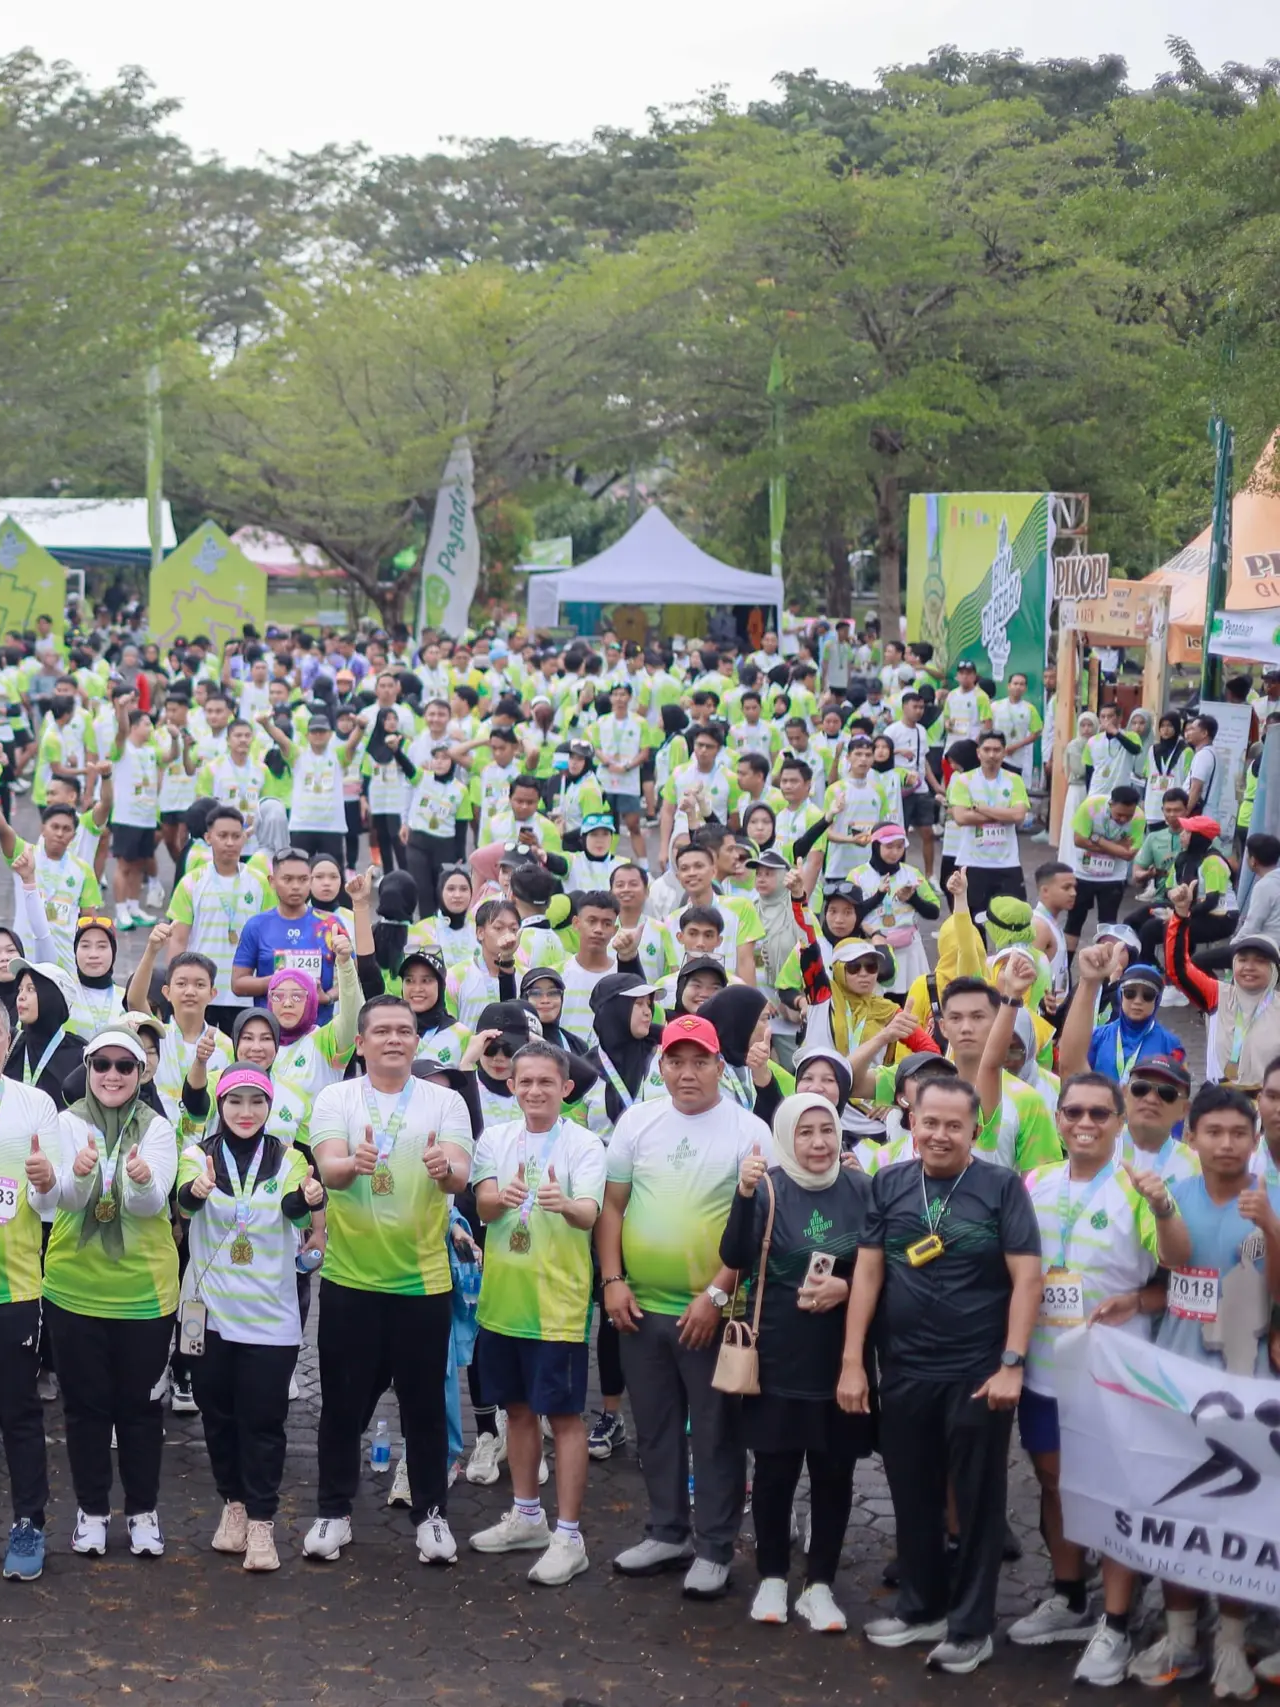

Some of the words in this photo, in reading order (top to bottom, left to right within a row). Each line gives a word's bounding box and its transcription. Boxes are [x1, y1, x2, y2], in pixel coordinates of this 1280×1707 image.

[1054, 553, 1109, 600] PIKOPI
[1225, 620, 1254, 639] Pegadaian
[287, 928, 301, 937] 09
[810, 1215, 824, 1226] RUN
[1040, 1286, 1080, 1304] 333
[1172, 1276, 1214, 1298] 7018
[1114, 1509, 1280, 1572] SMADA
[1104, 1536, 1187, 1577] RUNNING
[1197, 1566, 1277, 1596] COMMU
